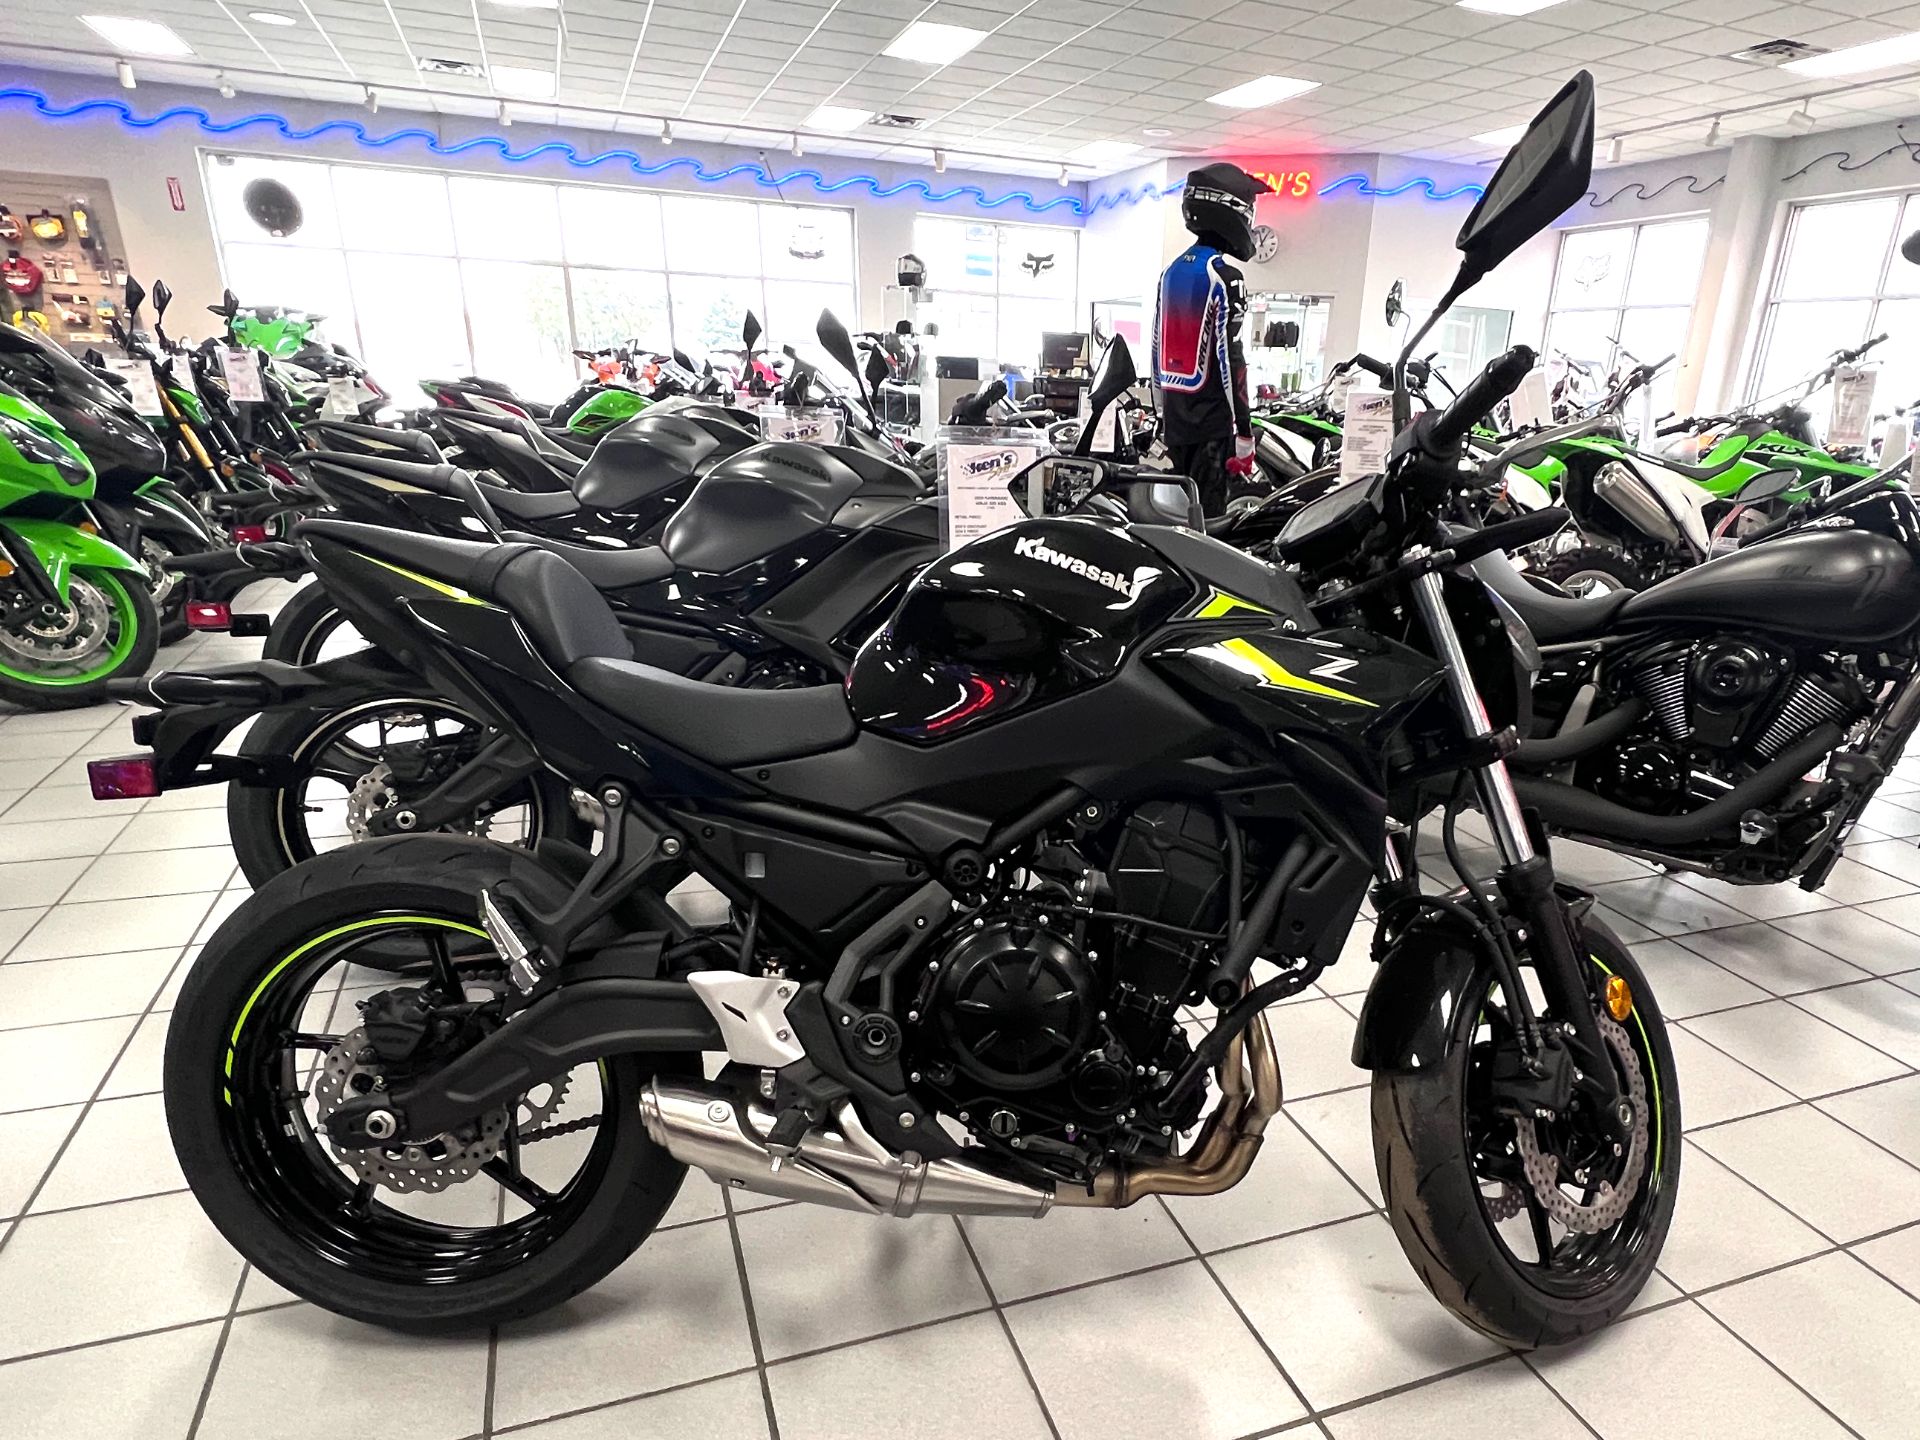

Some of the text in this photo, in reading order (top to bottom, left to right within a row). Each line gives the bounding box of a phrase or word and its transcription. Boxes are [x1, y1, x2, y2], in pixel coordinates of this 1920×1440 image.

[1754, 442, 1812, 458] KLX
[760, 451, 833, 483] Kawasaki
[1014, 536, 1137, 600] Kawasaki
